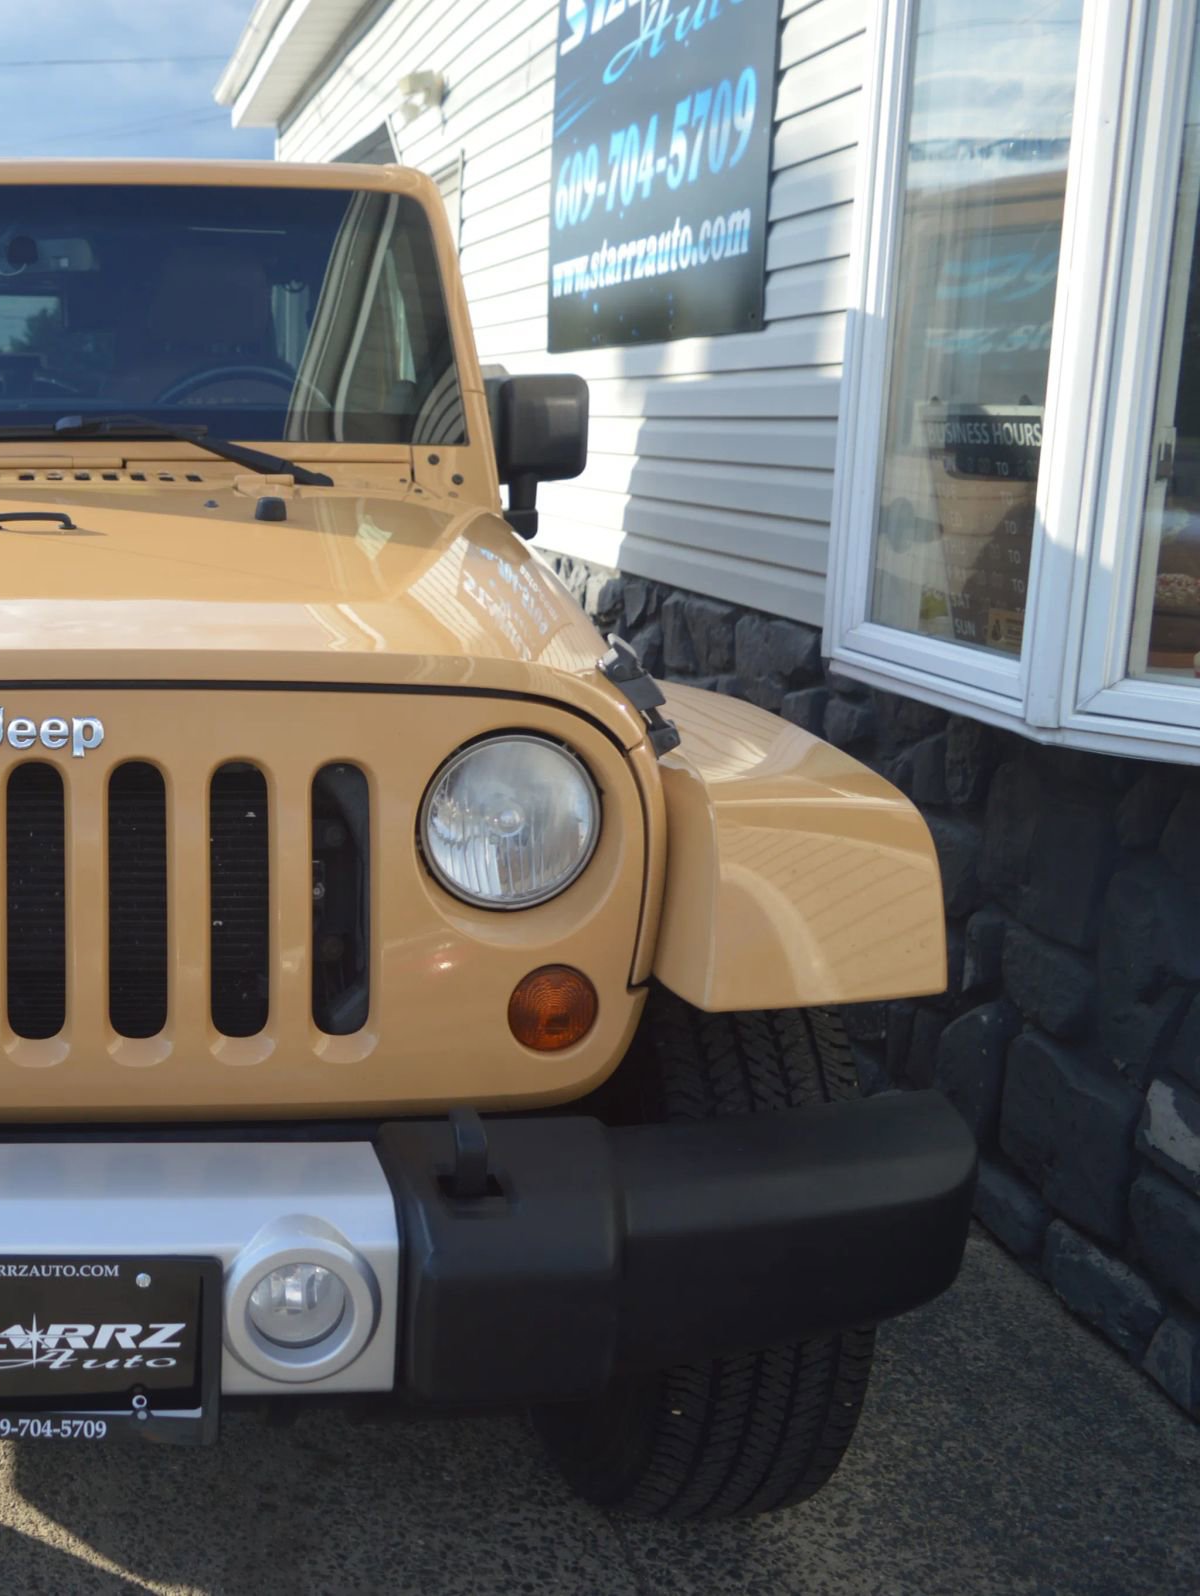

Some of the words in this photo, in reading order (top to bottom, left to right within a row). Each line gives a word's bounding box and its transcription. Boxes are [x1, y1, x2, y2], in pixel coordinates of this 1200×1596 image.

[602, 0, 745, 84] Au
[554, 65, 757, 231] 609-704-5709
[553, 207, 751, 298] www.starrzauto.com
[928, 421, 990, 445] BUSINESS
[992, 421, 1041, 446] HOURS
